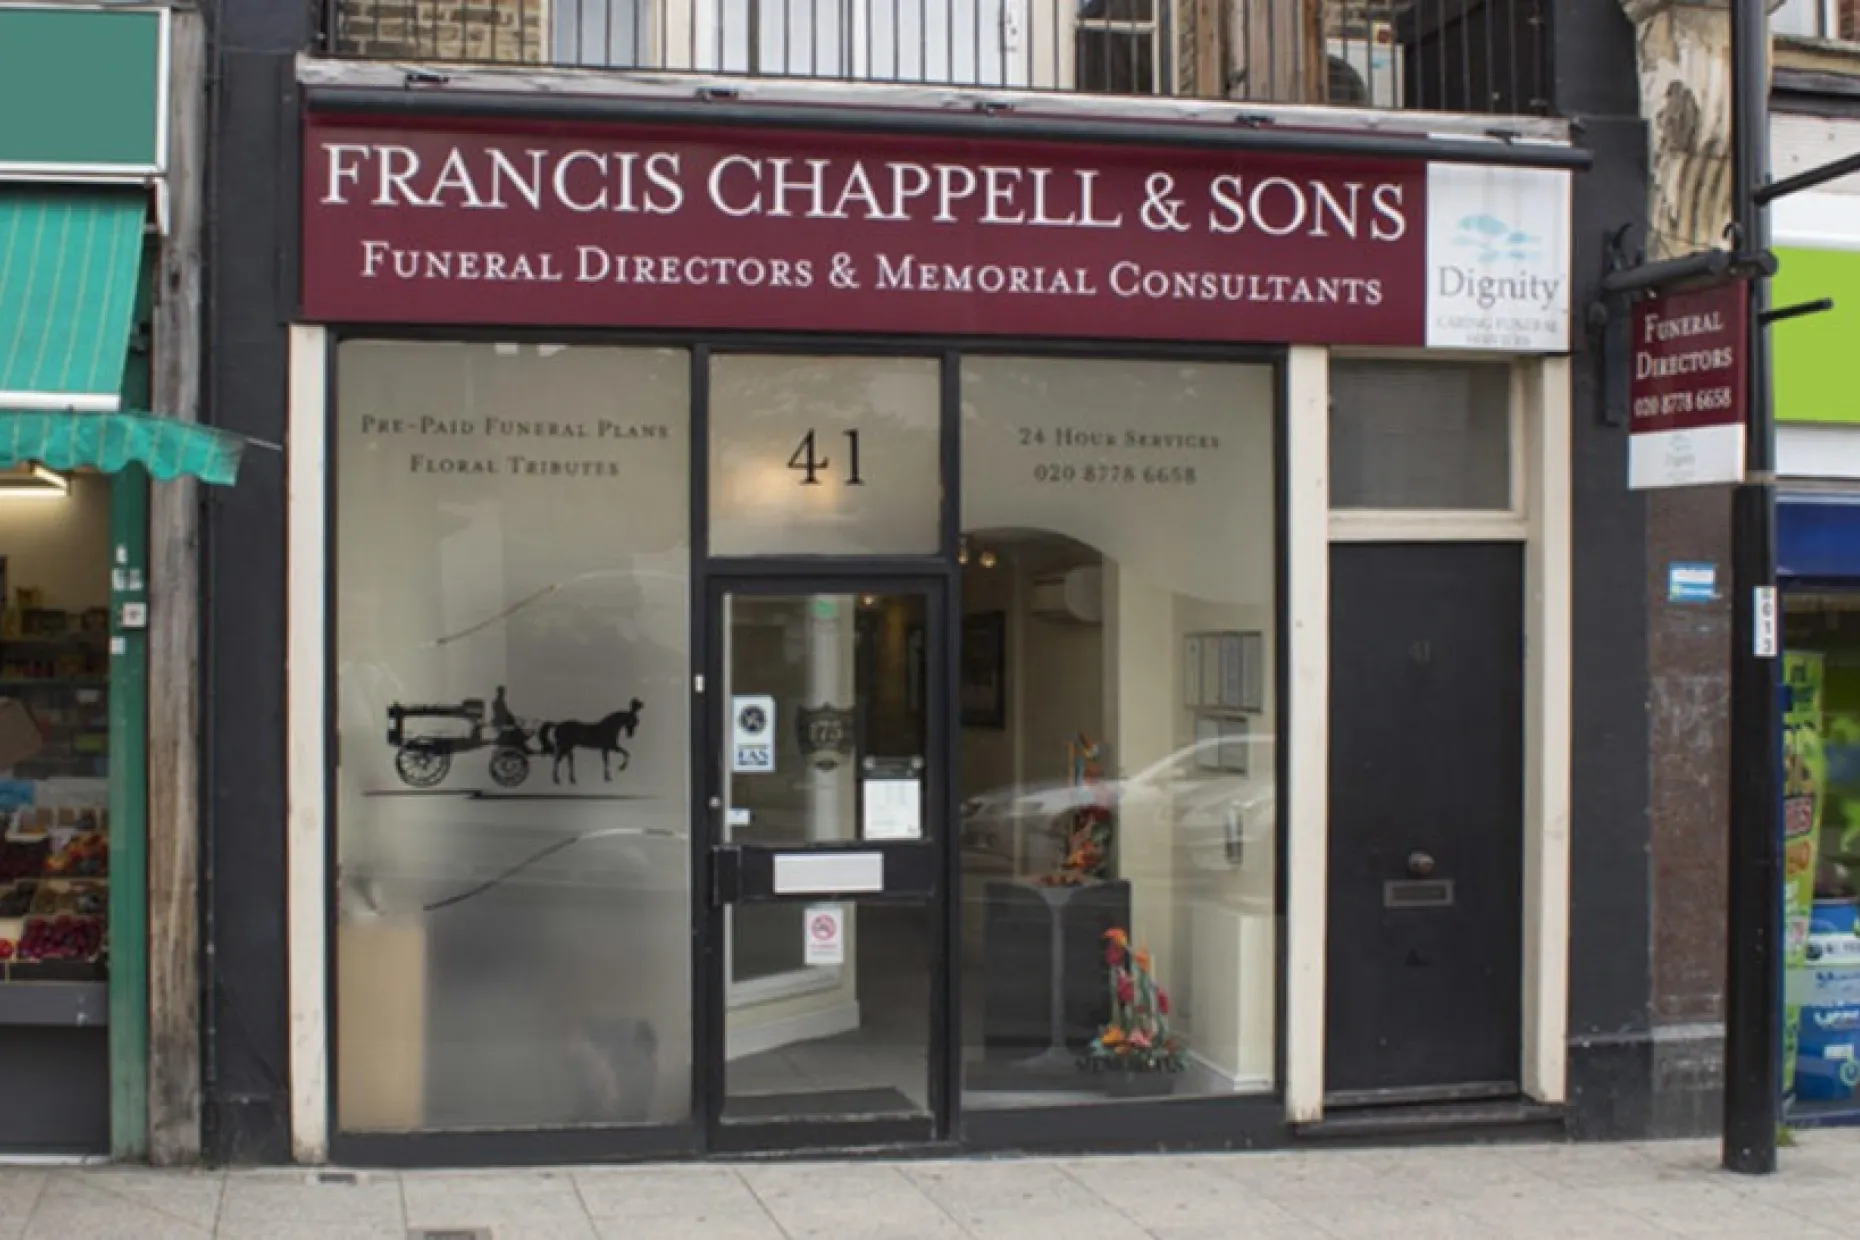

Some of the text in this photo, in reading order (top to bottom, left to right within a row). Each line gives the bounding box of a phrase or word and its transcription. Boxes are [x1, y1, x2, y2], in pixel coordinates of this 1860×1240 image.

[321, 143, 1406, 241] FRANCIS CHAPPELL & SONS
[361, 240, 1383, 305] FUNERAL DIRECTORS & MEMORIAL CONSULTANTS
[1438, 266, 1560, 311] Dignity
[1644, 312, 1723, 343] FUNERAL
[1636, 347, 1733, 379] DIRECTORS
[1696, 386, 1732, 411] 6658
[360, 414, 669, 439] PRE-PAID FUNERAL PLANS
[1018, 427, 1046, 446] 24
[410, 453, 619, 476] FLORAL TRIBUTES
[787, 428, 865, 485] 41
[1033, 463, 1197, 485] 020 8778 6658
